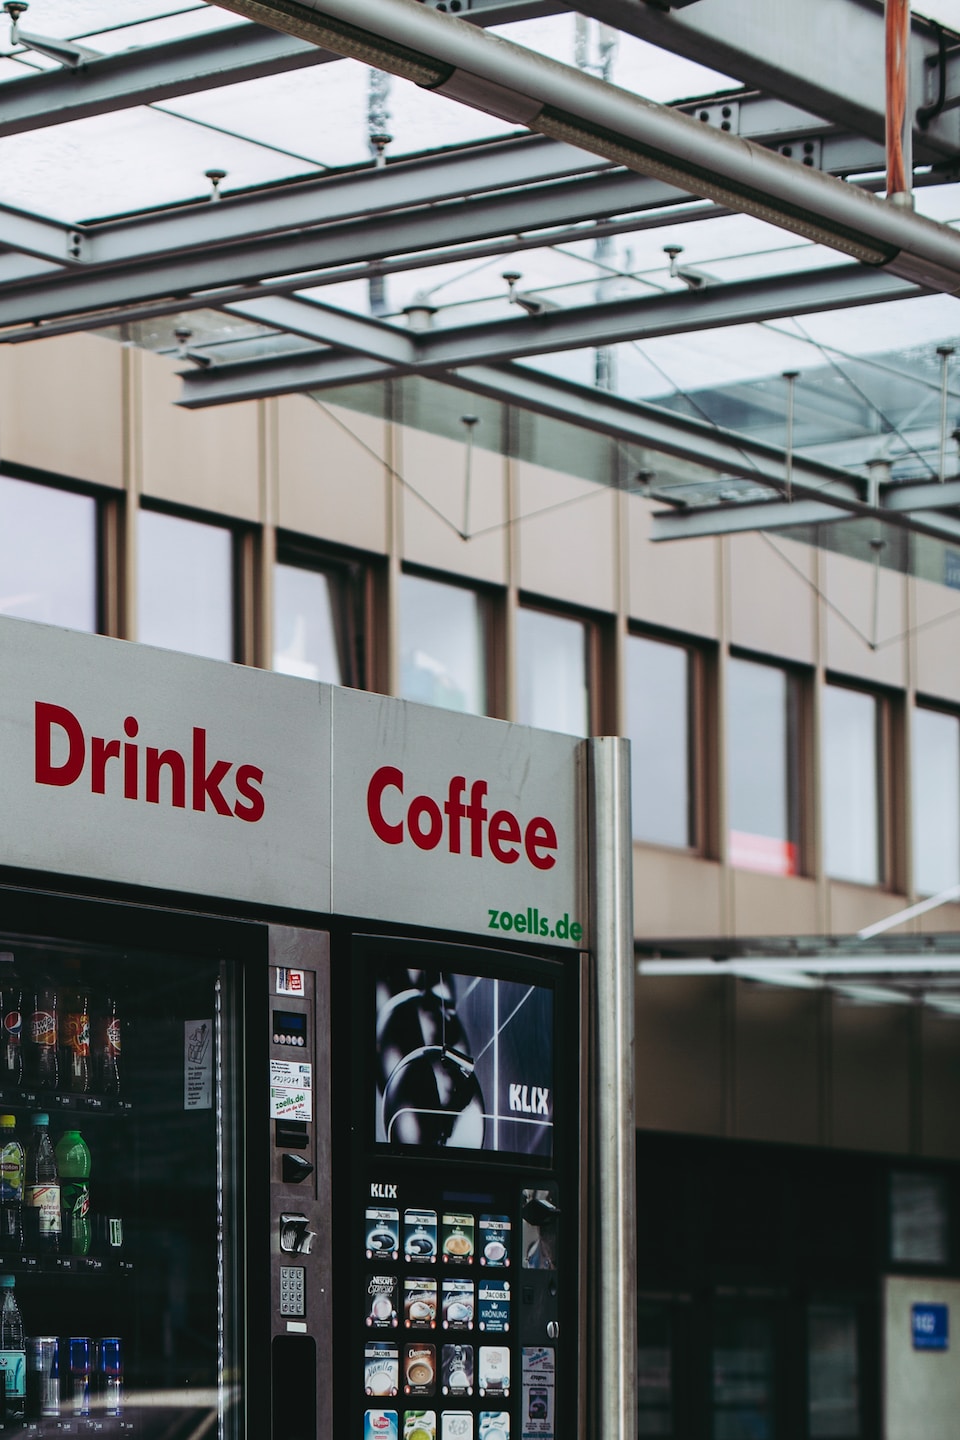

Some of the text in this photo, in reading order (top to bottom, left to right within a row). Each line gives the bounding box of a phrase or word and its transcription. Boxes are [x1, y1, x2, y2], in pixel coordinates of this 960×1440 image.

[34, 701, 265, 823] Drinks
[367, 766, 558, 870] Coffee
[488, 908, 583, 942] zoells.de
[509, 1083, 549, 1115] KLIX
[370, 1182, 398, 1199] KLIX
[485, 1289, 507, 1299] JACOBS
[481, 1309, 508, 1319] KRÖNUNG
[368, 1362, 393, 1377] Vanilla
